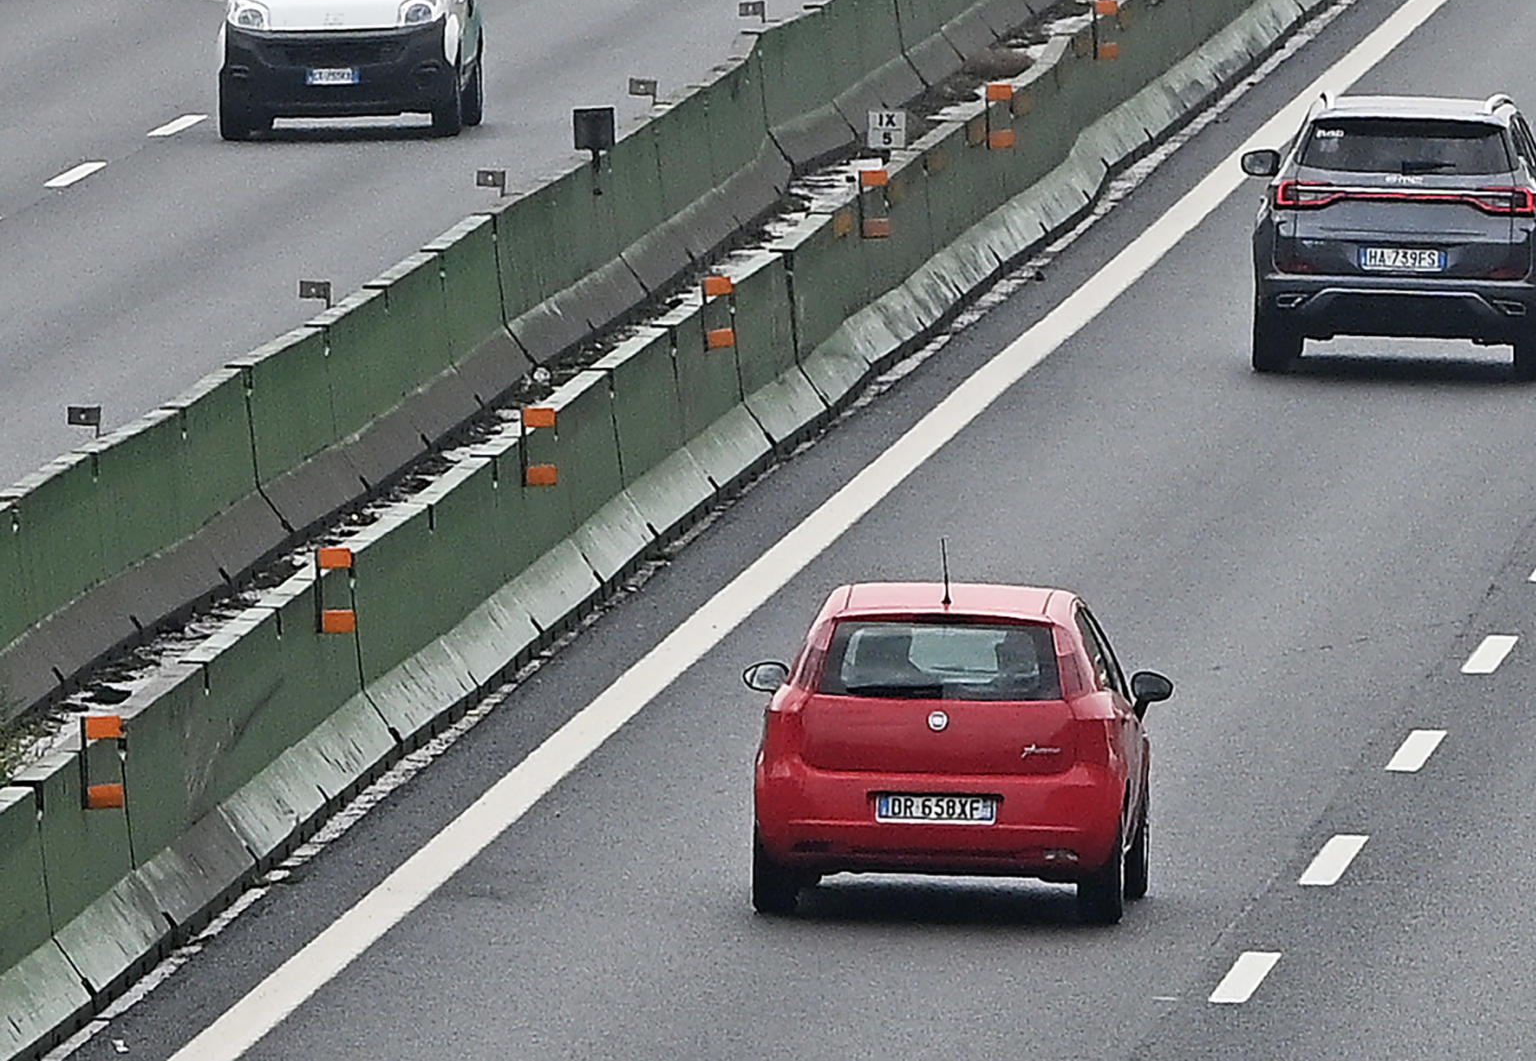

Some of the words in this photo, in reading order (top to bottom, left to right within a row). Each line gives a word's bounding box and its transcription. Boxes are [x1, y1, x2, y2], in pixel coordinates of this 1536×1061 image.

[878, 113, 896, 128] IX
[882, 131, 893, 146] 5
[1368, 250, 1386, 266] HA
[1388, 251, 1437, 267] 739FS
[890, 797, 914, 816] DR
[922, 797, 981, 820] 658XF
